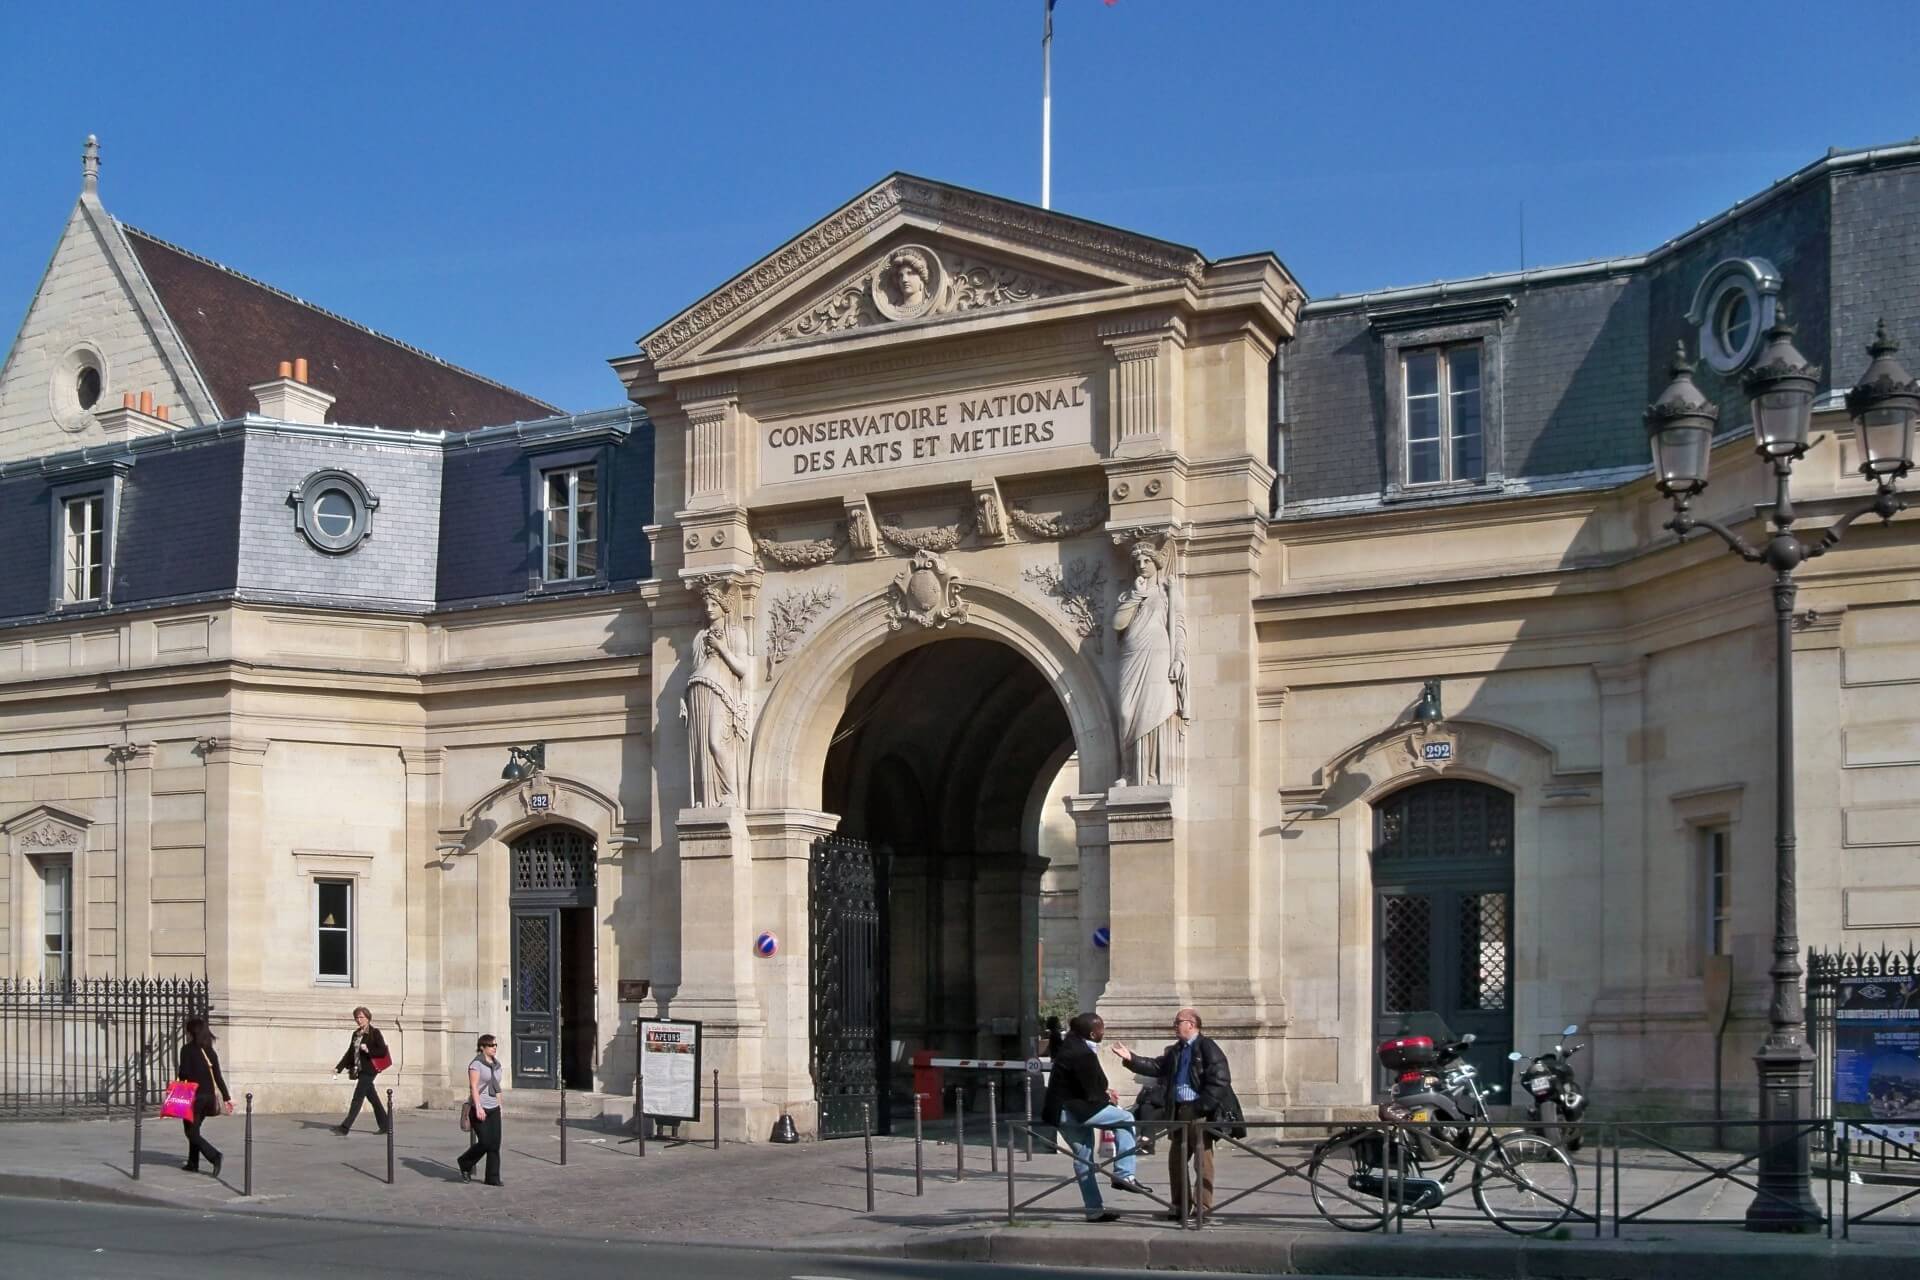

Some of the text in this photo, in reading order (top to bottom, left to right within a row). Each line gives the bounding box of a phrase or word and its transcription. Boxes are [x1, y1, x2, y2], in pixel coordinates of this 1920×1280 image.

[768, 386, 1085, 448] CONSERVATOIRE NATIONAL
[793, 421, 1055, 475] DES ARTS ET METIERS
[1426, 744, 1450, 758] 292
[532, 796, 547, 806] 292
[649, 1031, 680, 1042] VAPEURS
[1028, 1062, 1039, 1070] 20
